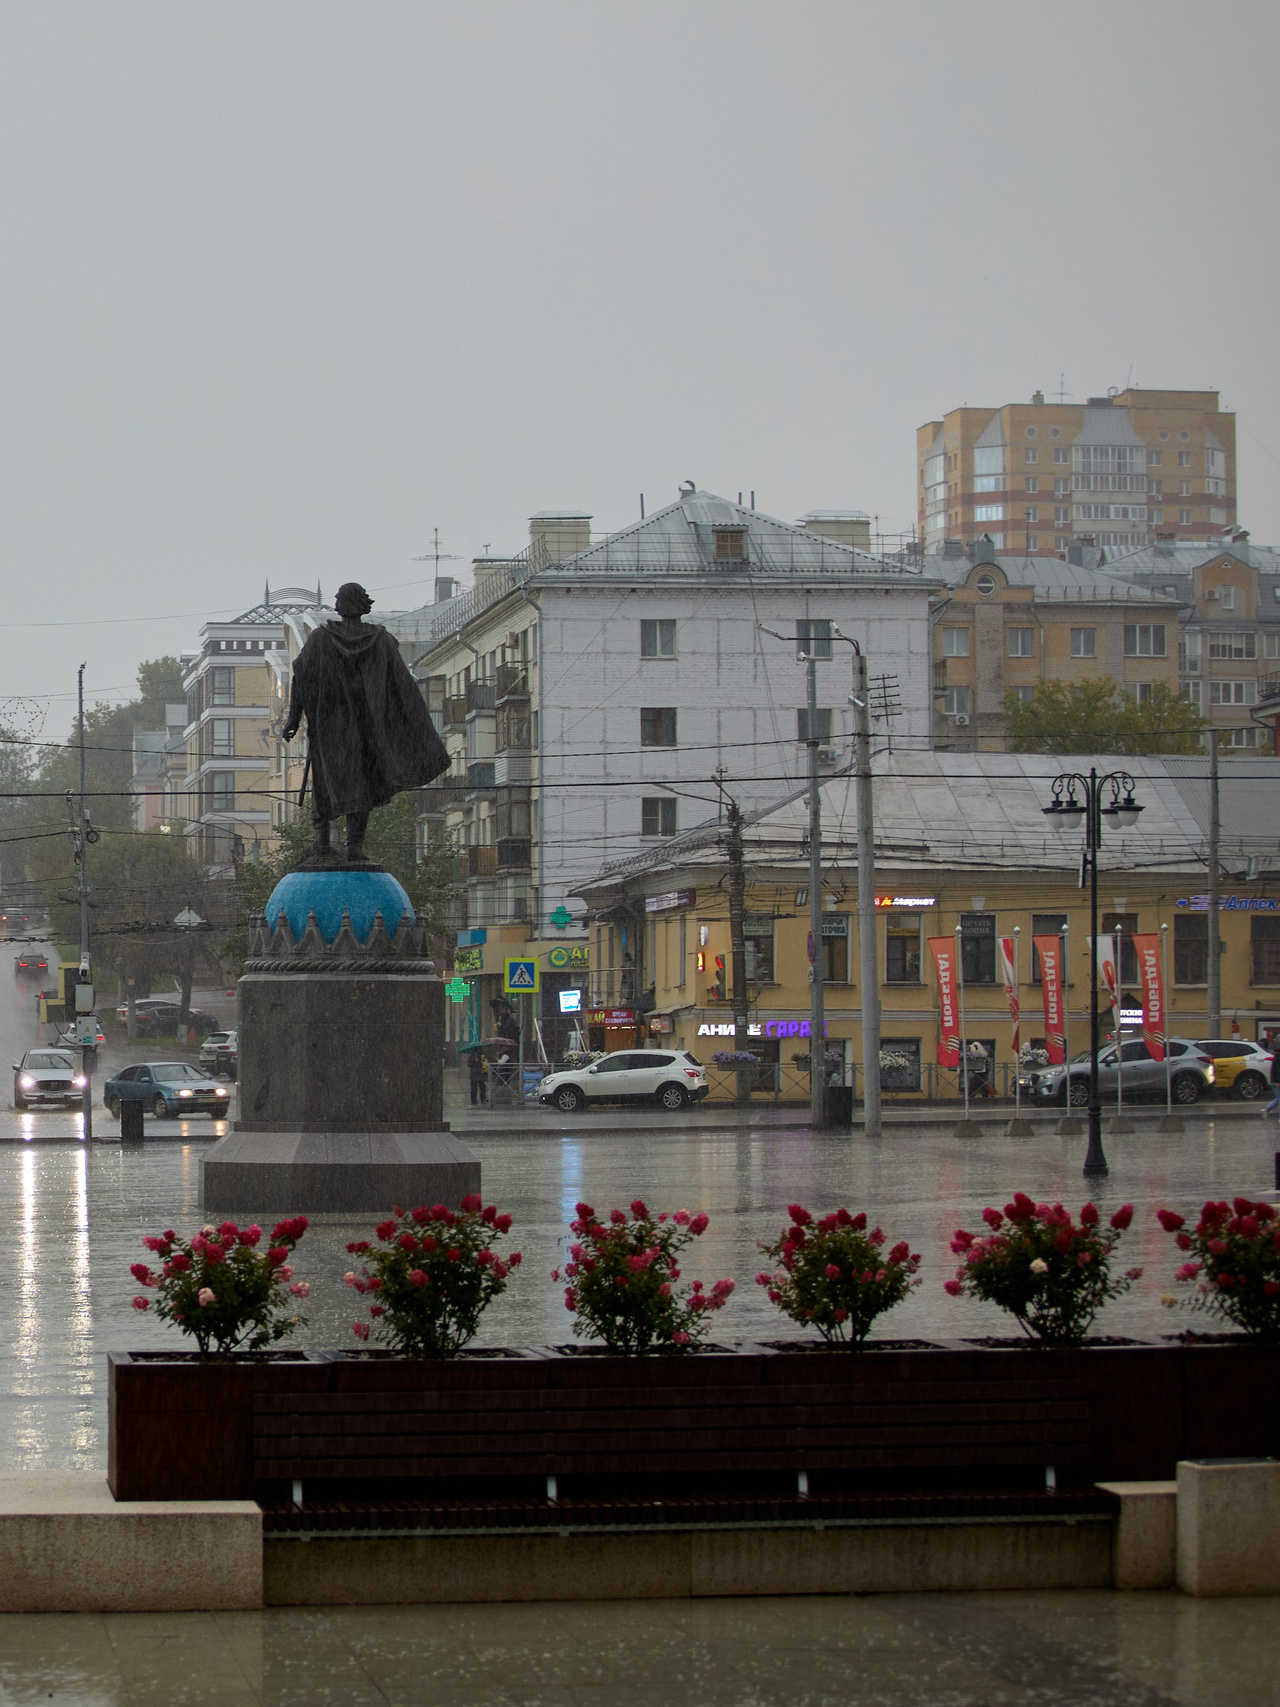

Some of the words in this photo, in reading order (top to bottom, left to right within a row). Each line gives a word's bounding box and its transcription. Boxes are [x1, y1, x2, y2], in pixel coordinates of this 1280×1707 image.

[1226, 895, 1280, 911] Аптек
[697, 1023, 762, 1037] АНИЕ
[765, 1020, 828, 1039] ГАРА
